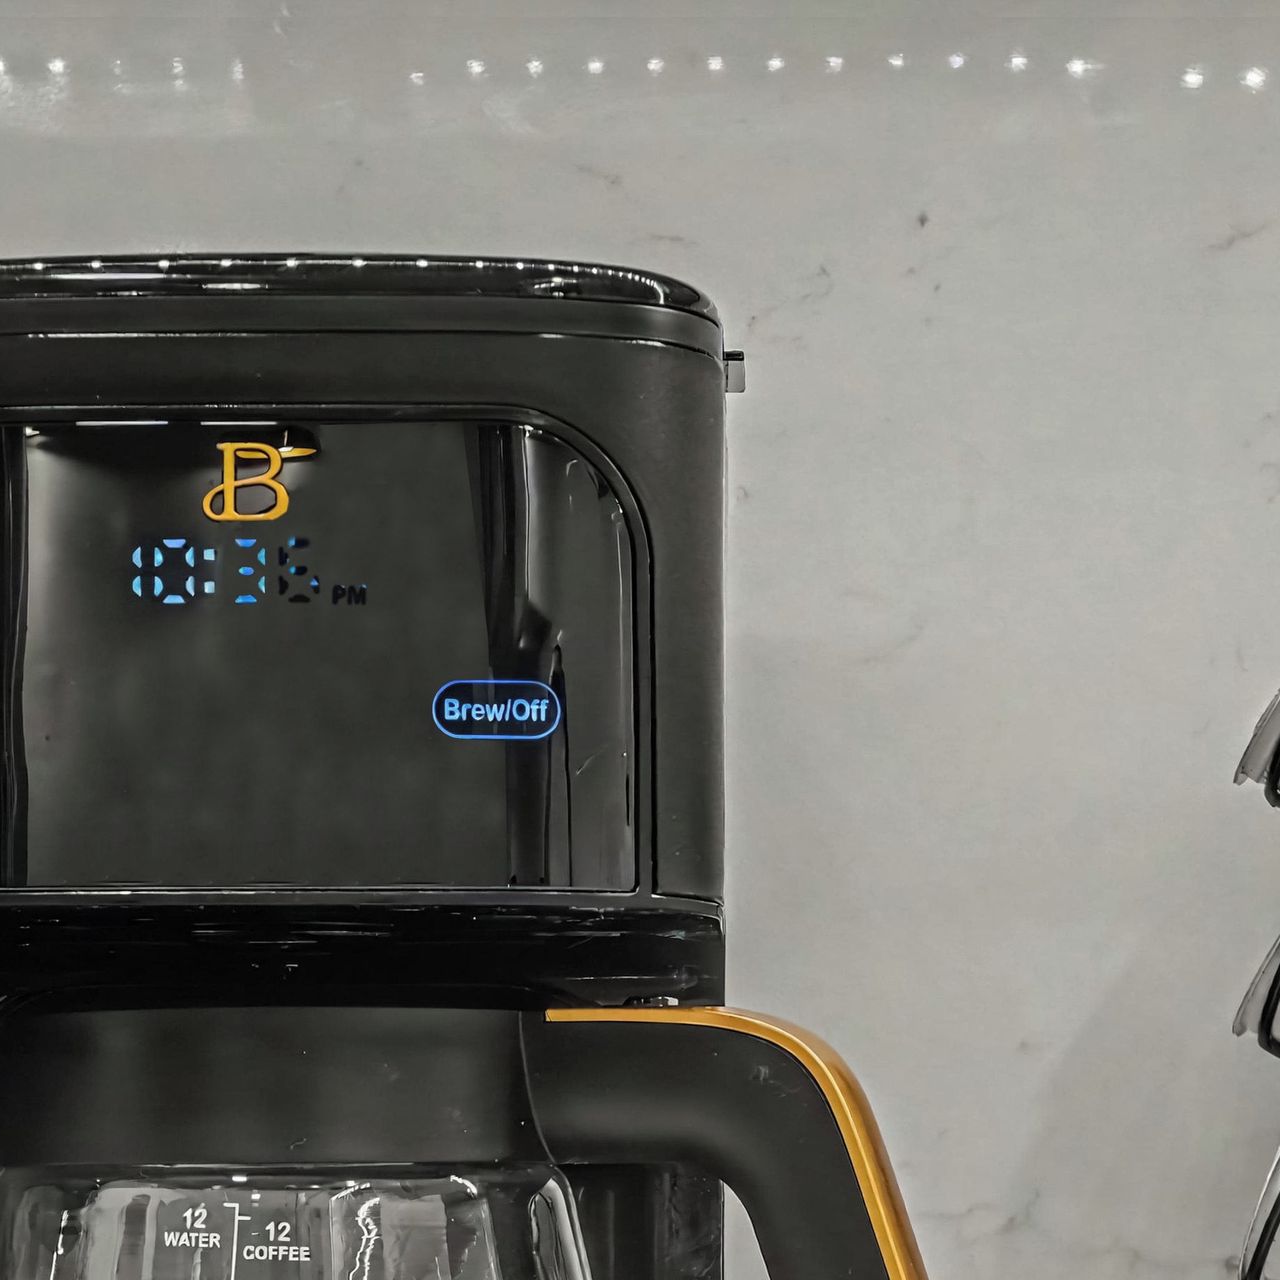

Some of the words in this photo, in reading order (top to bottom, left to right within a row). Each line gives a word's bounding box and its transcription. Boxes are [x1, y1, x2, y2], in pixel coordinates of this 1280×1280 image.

[444, 698, 549, 722] Brew/Off
[182, 1208, 208, 1229] 12
[163, 1232, 221, 1248] WATER
[265, 1221, 291, 1242] 12
[242, 1245, 311, 1262] COFFEE
